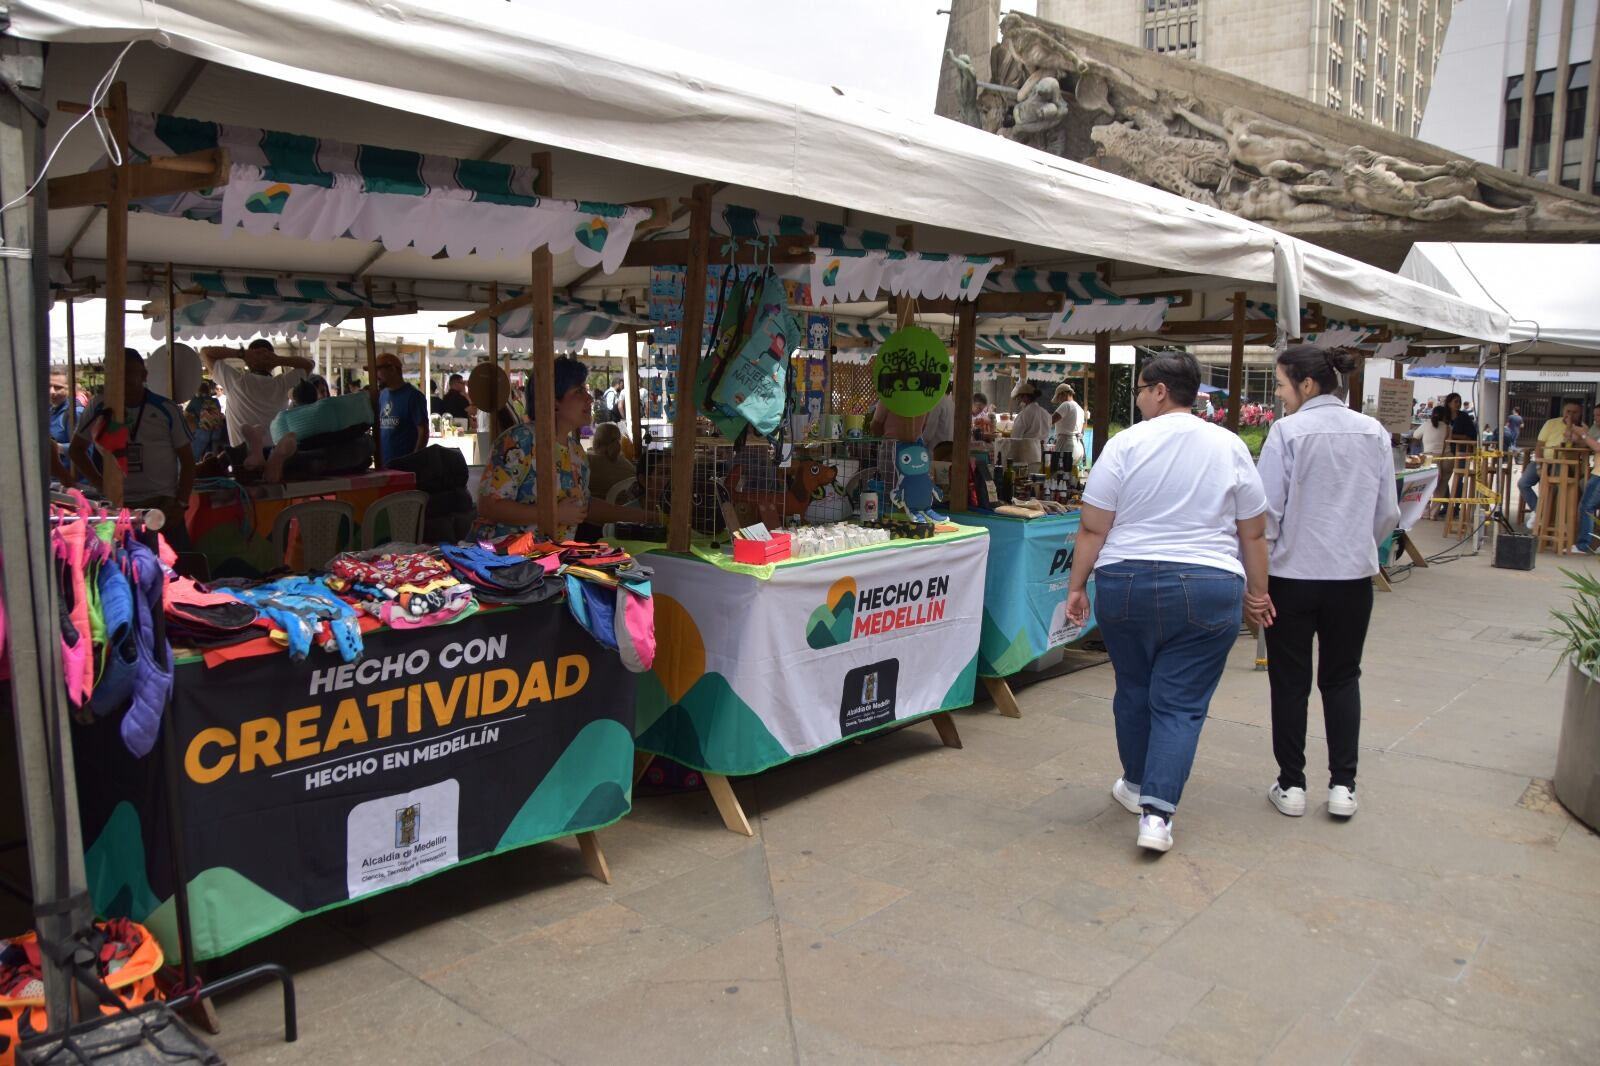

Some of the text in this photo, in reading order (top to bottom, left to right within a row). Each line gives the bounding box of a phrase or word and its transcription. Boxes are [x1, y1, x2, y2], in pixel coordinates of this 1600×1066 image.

[853, 598, 945, 638] MEDELLÍN
[858, 575, 949, 612] HECHO EN
[309, 634, 508, 696] HECHO CON
[184, 654, 590, 785] CREATIVIDAD
[305, 726, 500, 791] HECHO EN MEDELLÍN
